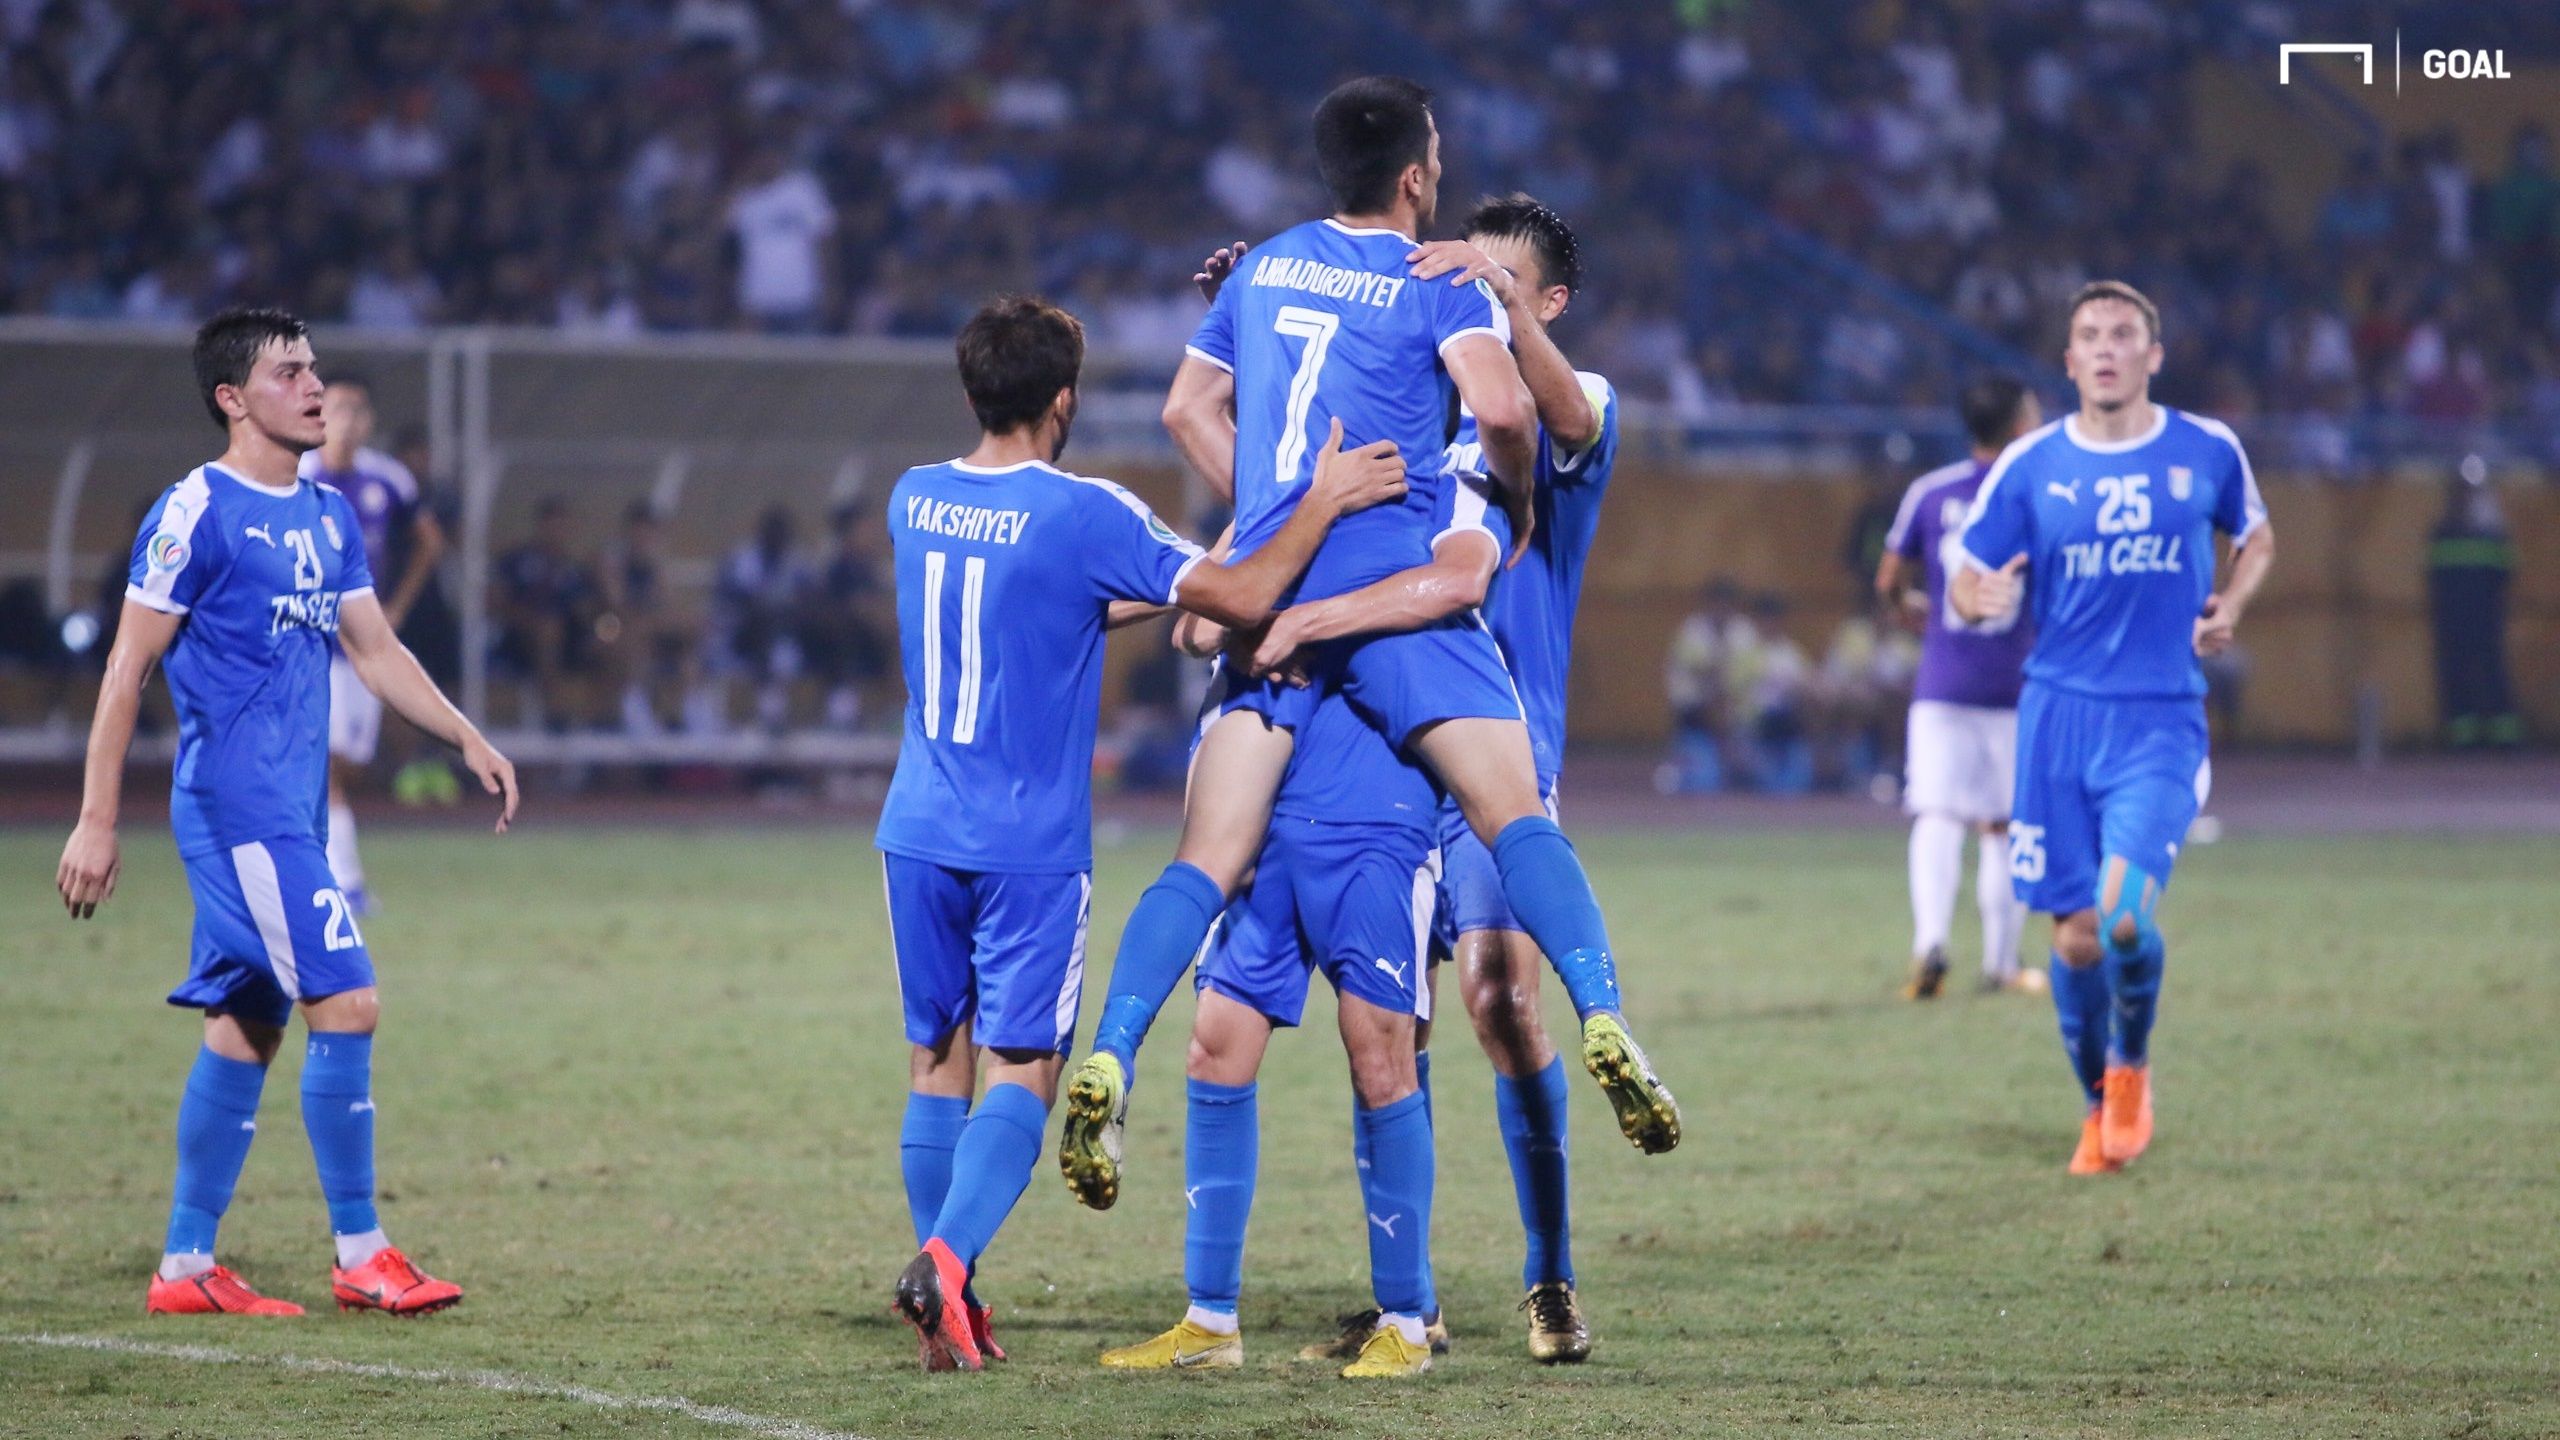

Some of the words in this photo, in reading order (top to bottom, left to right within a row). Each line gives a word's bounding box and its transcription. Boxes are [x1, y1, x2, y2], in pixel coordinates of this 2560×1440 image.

[1274, 305, 1340, 482] 7
[907, 495, 1030, 545] YAKSHIYEV
[2094, 474, 2152, 534] 25
[283, 529, 323, 591] 21
[2063, 541, 2104, 580] TM
[2109, 534, 2182, 576] CELL
[923, 551, 985, 744] 11
[2007, 819, 2046, 882] 25
